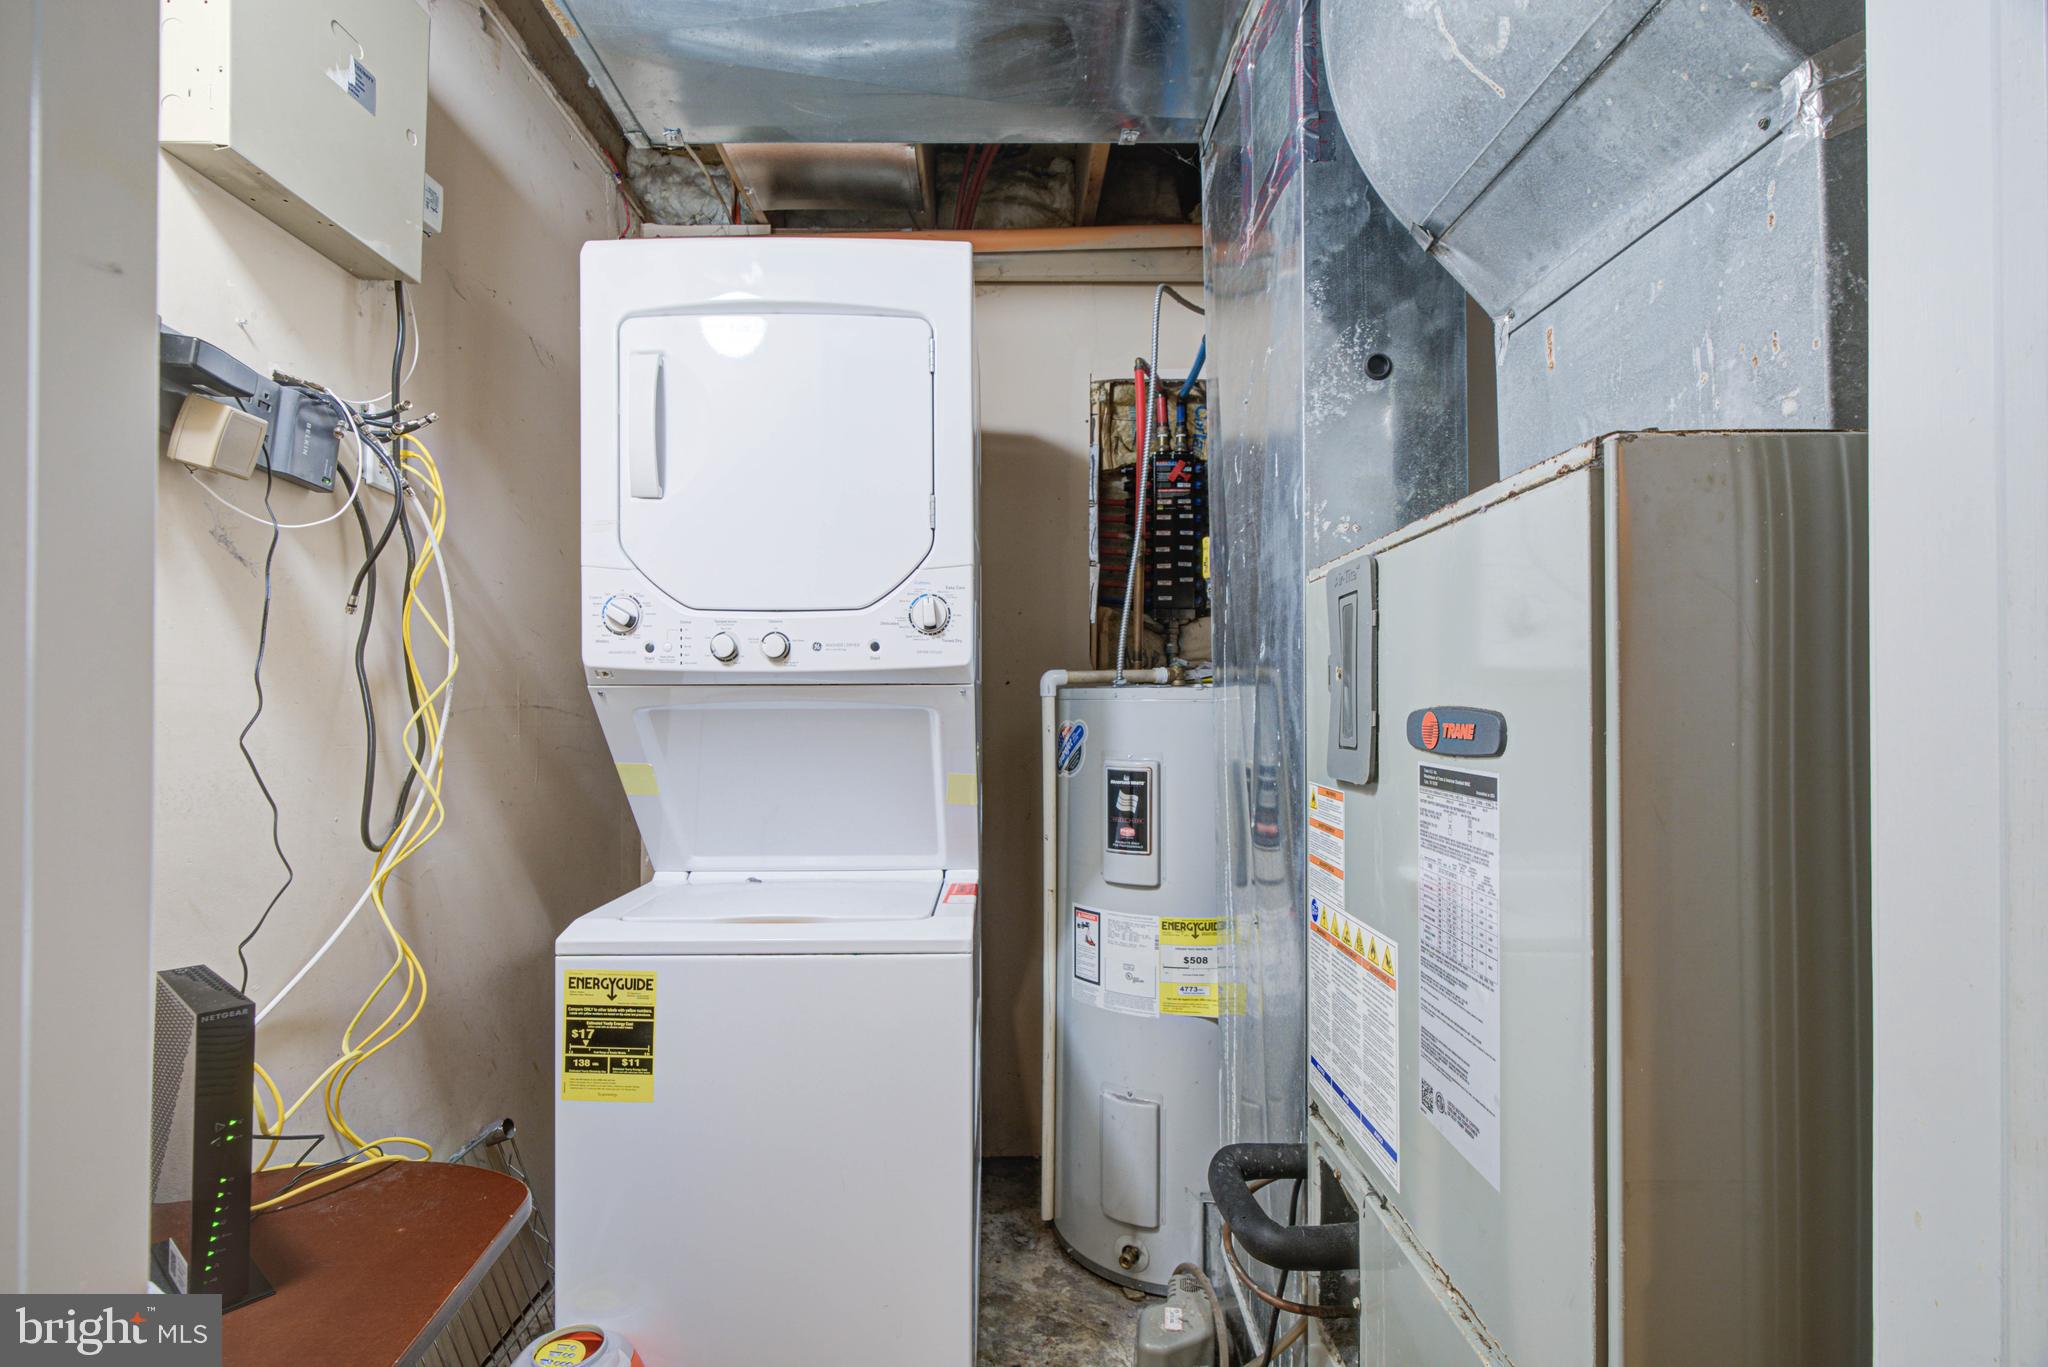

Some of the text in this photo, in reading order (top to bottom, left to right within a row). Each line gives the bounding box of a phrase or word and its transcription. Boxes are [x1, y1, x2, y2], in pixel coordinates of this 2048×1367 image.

[1442, 723, 1476, 741] TRANE
[1183, 956, 1208, 965] $508
[568, 976, 654, 991] ENERGYGUIDE
[201, 1008, 249, 1024] NETGEAR
[571, 1028, 595, 1039] $17
[572, 1058, 591, 1067] 138
[621, 1058, 640, 1067] $11
